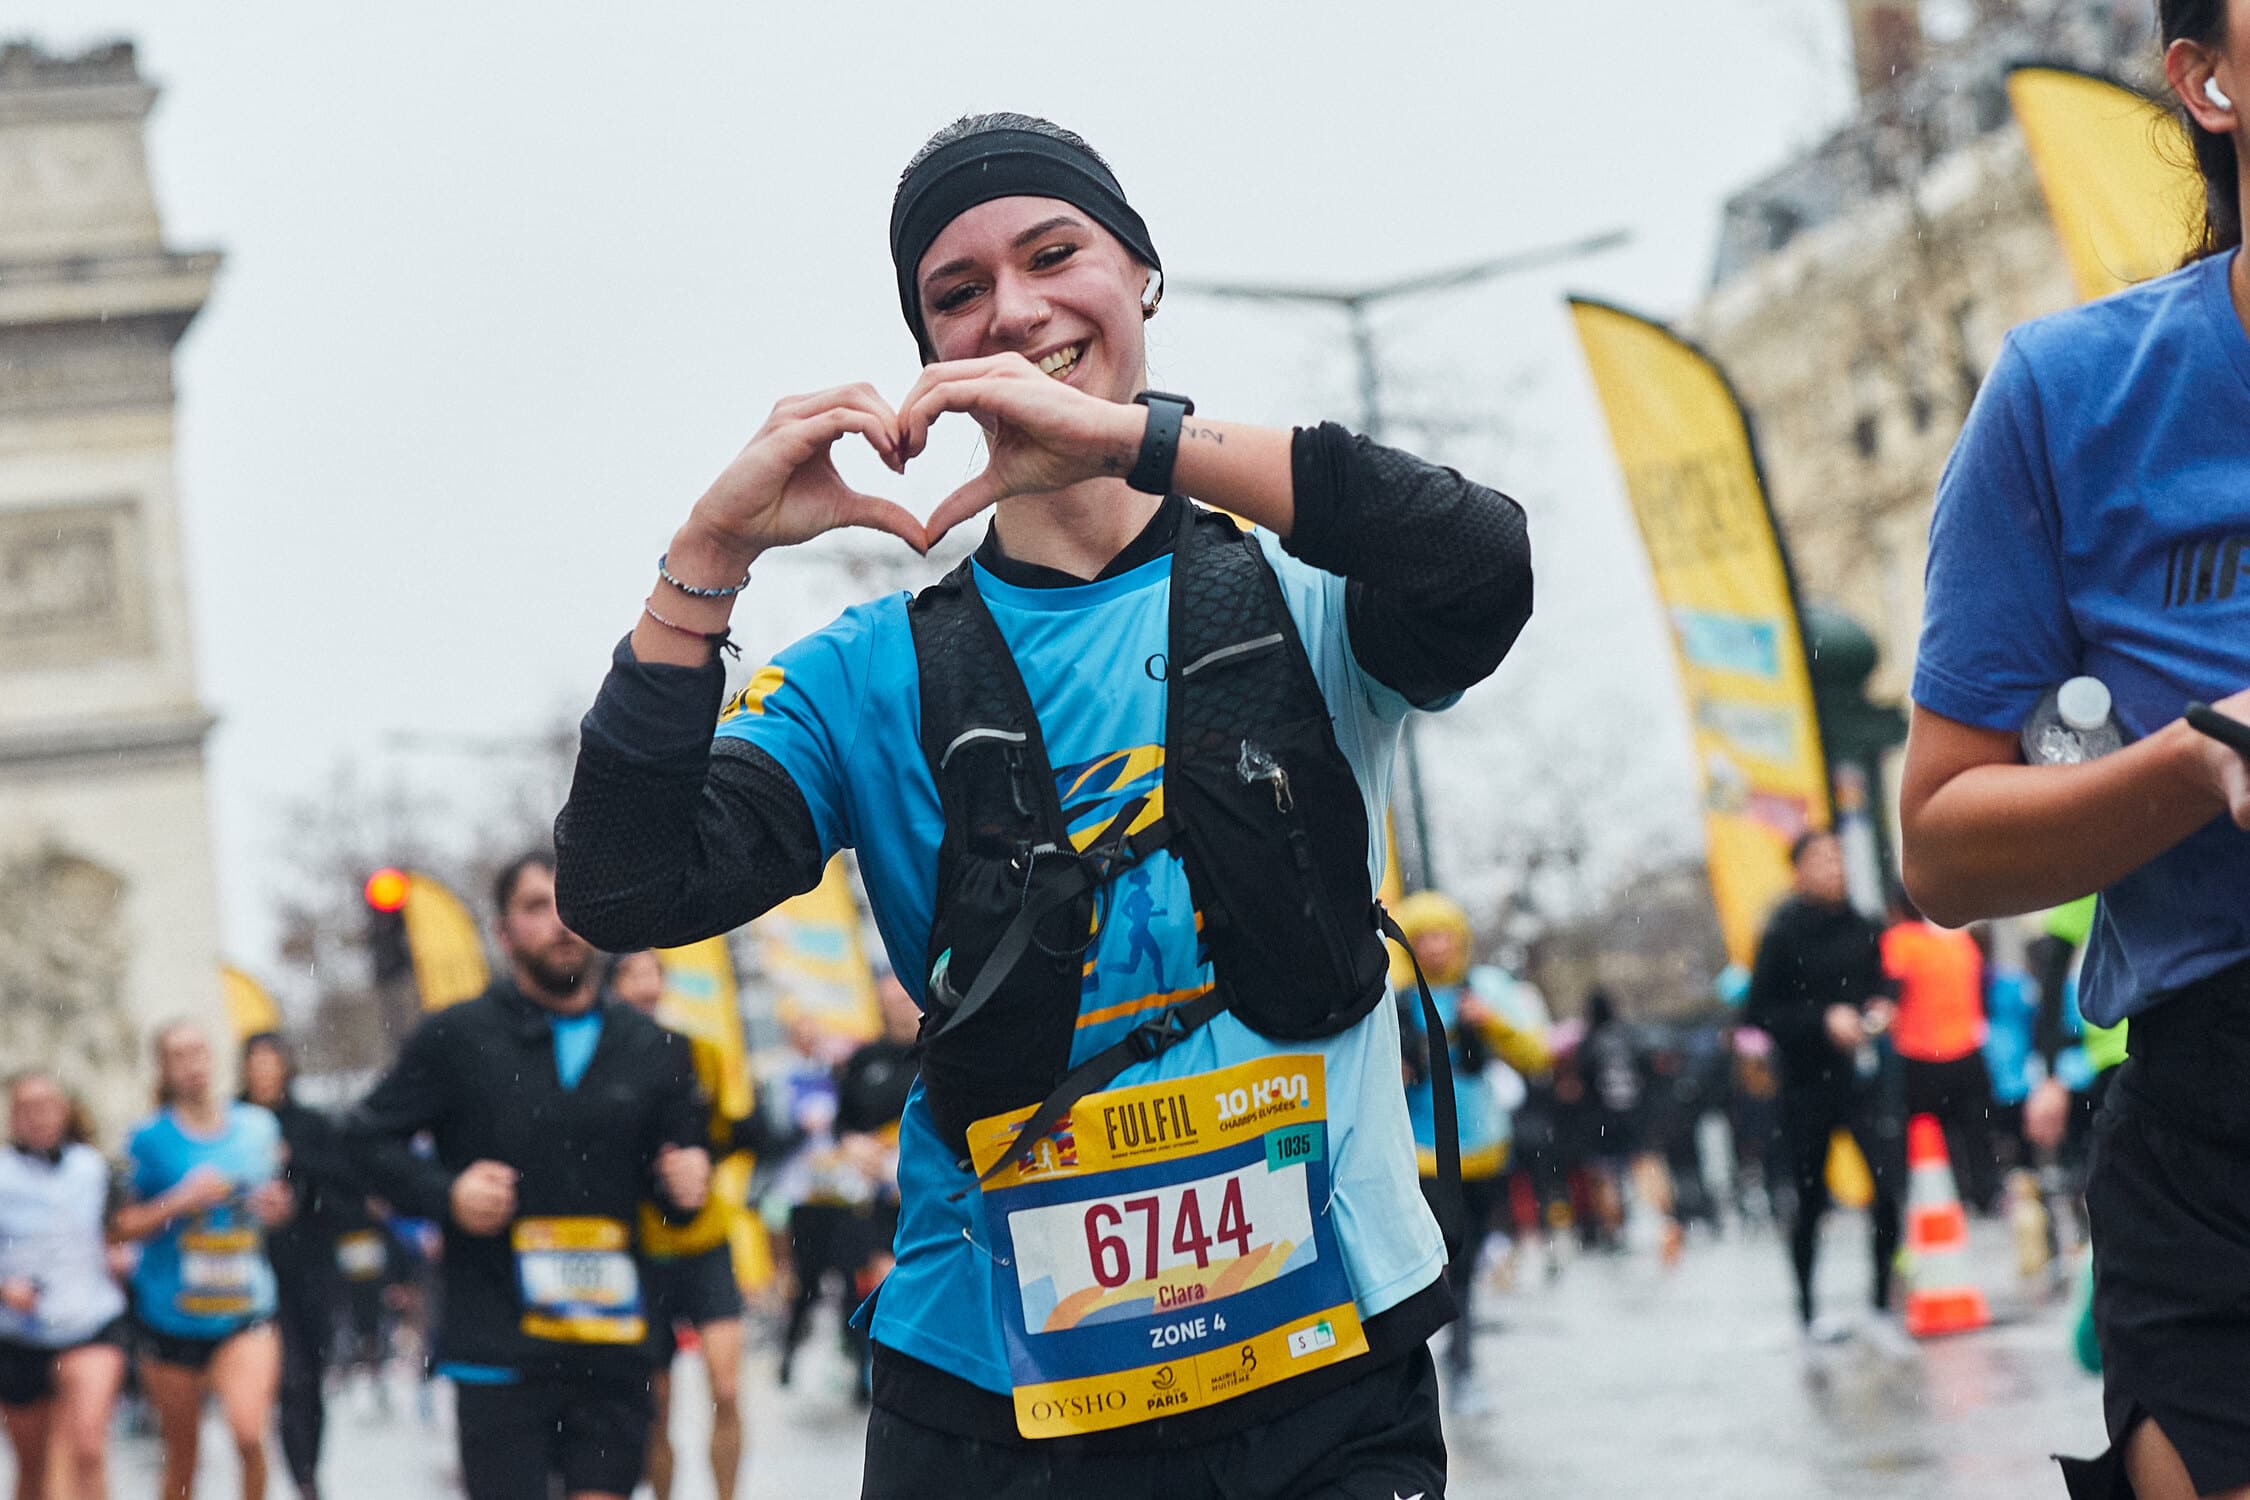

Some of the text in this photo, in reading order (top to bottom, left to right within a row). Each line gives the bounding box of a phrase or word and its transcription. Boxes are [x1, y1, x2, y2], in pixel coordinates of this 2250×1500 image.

[1215, 1088, 1248, 1121] 10
[1103, 1094, 1197, 1151] FULFIL
[1277, 1134, 1310, 1160] 1035
[1083, 1176, 1254, 1288] 6744
[1159, 1283, 1205, 1308] Clara
[1149, 1313, 1226, 1348] ZONE 4
[1031, 1390, 1126, 1422] OYSHO
[1147, 1392, 1188, 1411] PARIS
